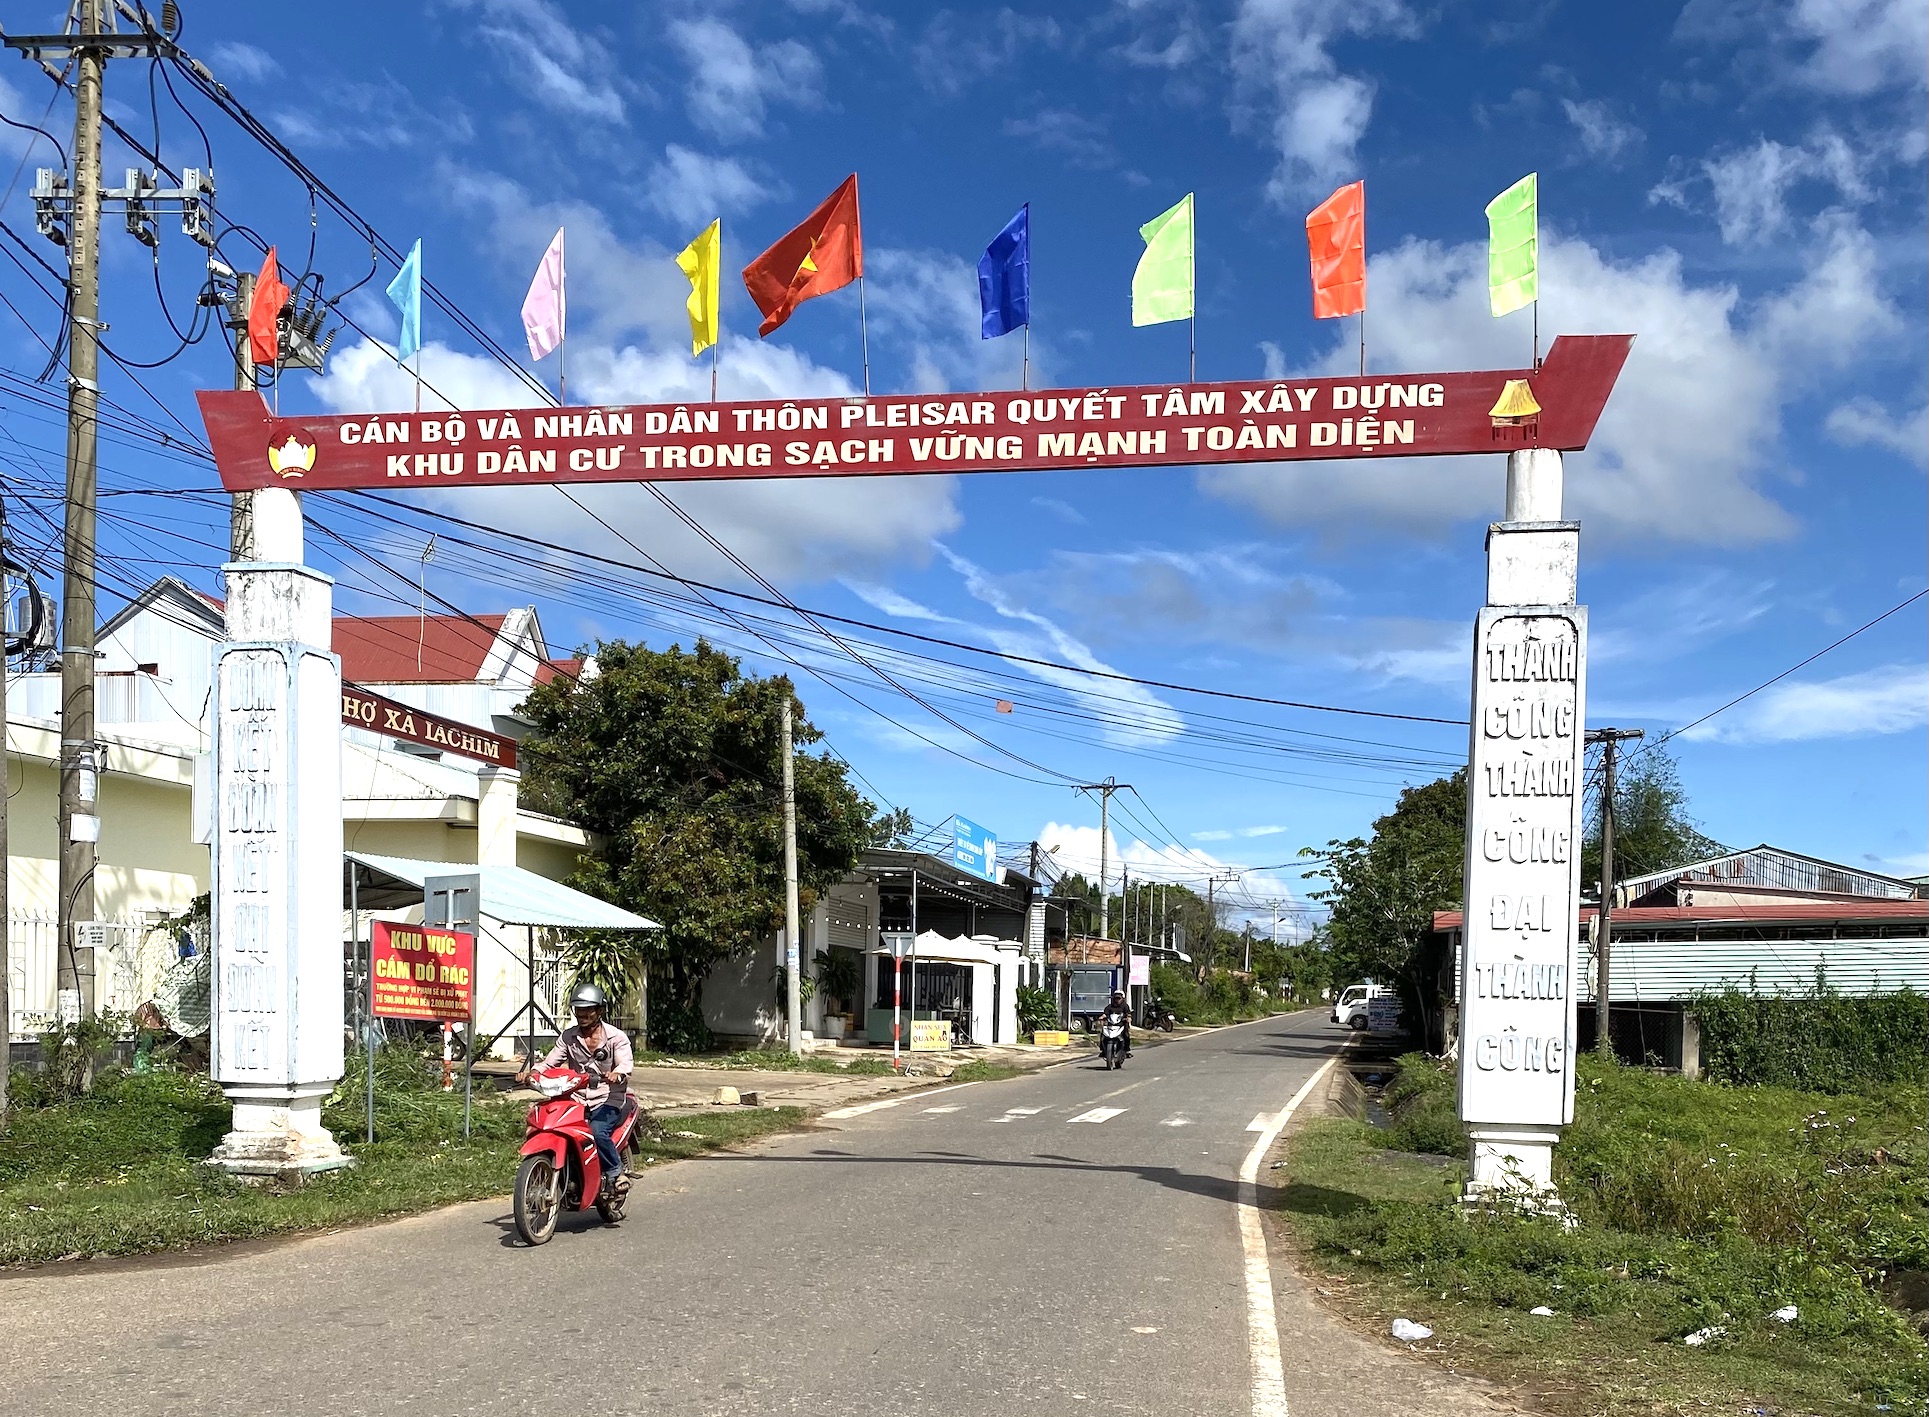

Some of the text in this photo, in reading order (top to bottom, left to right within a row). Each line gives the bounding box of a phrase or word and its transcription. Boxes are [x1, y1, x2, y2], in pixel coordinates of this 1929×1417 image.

[339, 382, 1444, 447] CÁN BỘ VÀ NHÂN DÂN THÔN PLEISAR QUYẾT TÂM XÂY DỰNG
[386, 452, 464, 478] KHU
[477, 444, 557, 474] DÂN
[569, 444, 626, 471] CƯ
[639, 443, 772, 469] TRONG
[784, 438, 894, 470] SẠCH
[908, 429, 1023, 462] VỮNG
[1037, 430, 1167, 462] MẠNH
[1181, 419, 1297, 451] TOÀN
[1486, 635, 1577, 682] THÀNH
[424, 720, 500, 760] IACHIM
[1484, 695, 1572, 739] CÔNG
[1484, 750, 1574, 797] THÀNH
[1483, 811, 1570, 864] CÔNG
[1489, 894, 1553, 940] ĐẠI
[391, 930, 456, 957] KHU VỰC
[375, 954, 410, 980] CẤM
[440, 964, 469, 986] RÁC
[1475, 954, 1566, 1000] THÀNH
[1475, 1025, 1563, 1074] CÔNG
